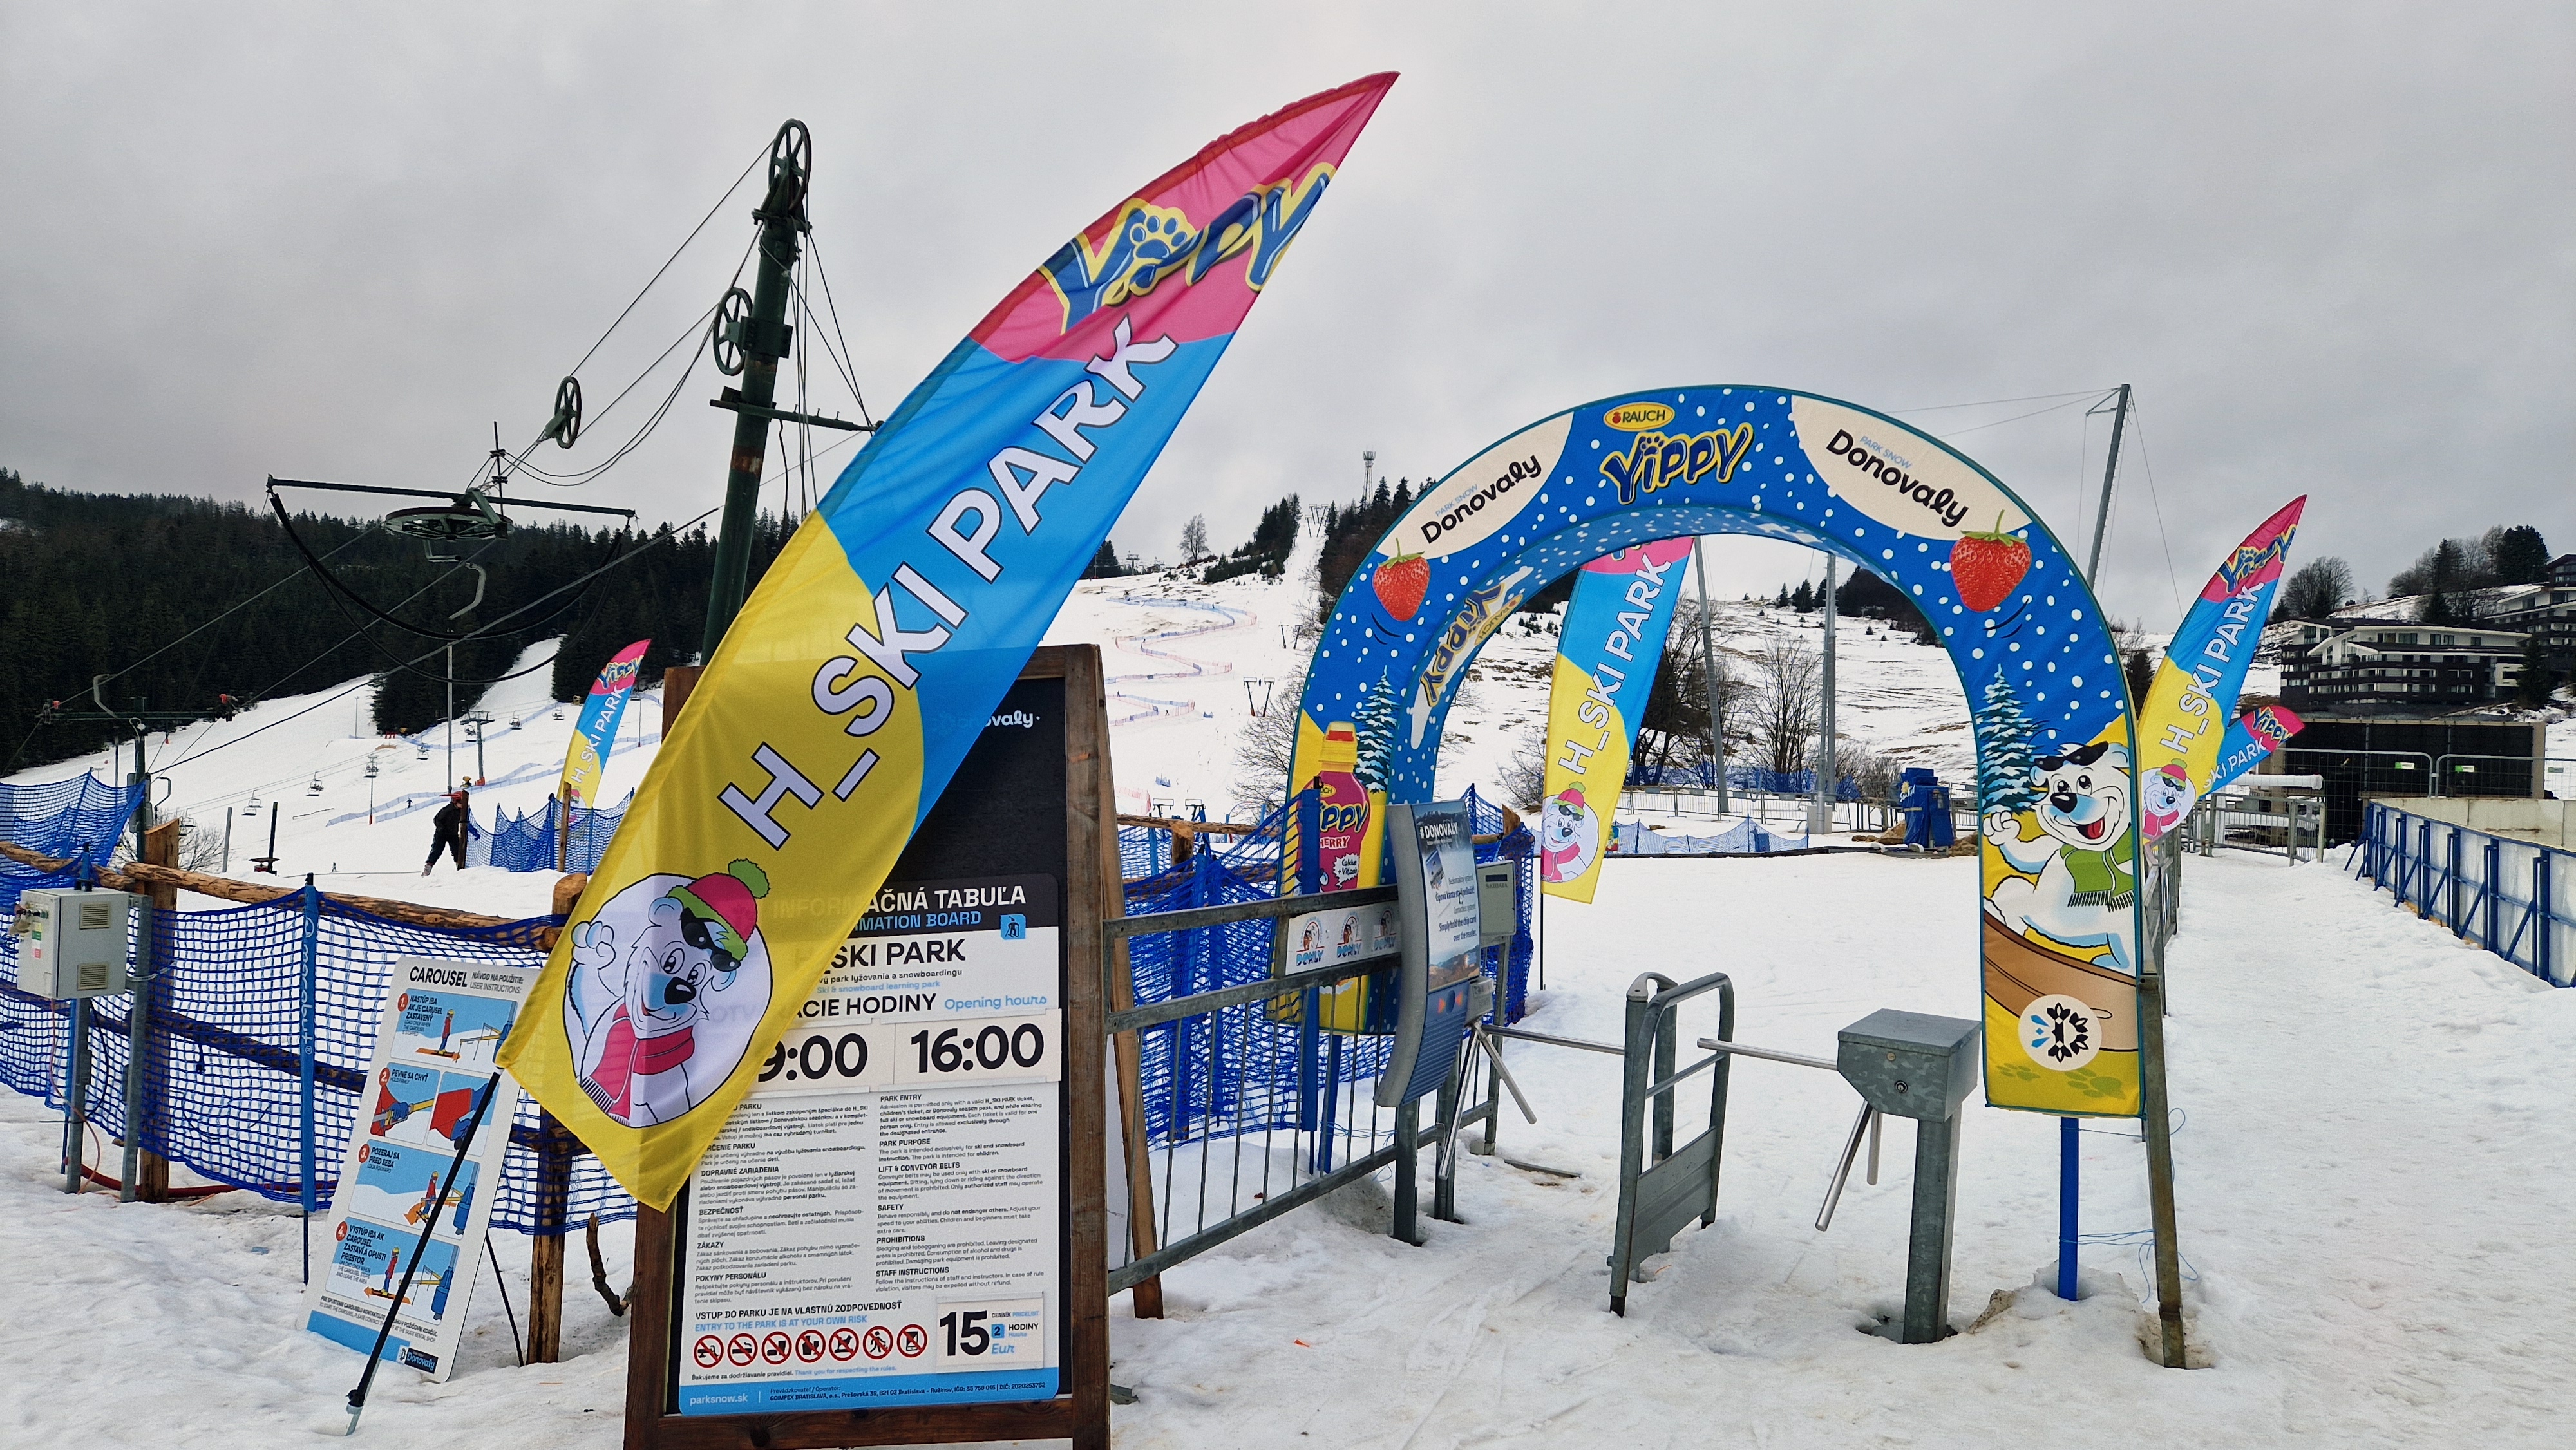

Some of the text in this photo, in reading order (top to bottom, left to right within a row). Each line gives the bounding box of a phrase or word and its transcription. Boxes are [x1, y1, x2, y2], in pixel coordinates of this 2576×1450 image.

[1621, 408, 1667, 424] RAUCH
[925, 314, 1180, 585] PARK
[1859, 435, 1913, 469] PARK SNOW
[1826, 429, 1969, 527] Donovaly
[1421, 455, 1542, 544] Donovaly
[1435, 484, 1479, 517] PARK SNOW
[1604, 553, 1672, 662] PARK
[2204, 582, 2265, 663] PARK
[594, 684, 625, 733] PARK
[2228, 736, 2266, 772] PARK
[934, 885, 1026, 909] TABUĽA
[926, 911, 981, 927] BOARD
[886, 938, 966, 965] PARK
[410, 966, 468, 988] CAROUSEL
[472, 970, 490, 980] NÁVOD
[831, 975, 849, 984] park
[851, 972, 890, 983] lyžovania
[899, 968, 962, 979] snowboardingu
[484, 983, 522, 993] INSTRUCTIONS:
[817, 985, 829, 994] Ski
[838, 983, 884, 992] snowboard
[886, 981, 920, 991] learning
[922, 980, 940, 988] park
[410, 995, 429, 1004] NASTÚP
[846, 993, 937, 1015] HODINY
[944, 997, 1001, 1012] Opening
[1005, 995, 1047, 1006] hours
[911, 1022, 1045, 1073] 16:00
[368, 1156, 394, 1168] PRED SEBA
[701, 1166, 779, 1176] DOPRAVNÉ ZARIADENIA
[699, 1206, 744, 1216] BEZPEČNOSŤ
[346, 1234, 372, 1247] CAROUSEL
[377, 1232, 385, 1241] AK
[876, 1235, 925, 1243] PROHIBITIONS
[726, 1272, 766, 1281] PERSONÁLU
[898, 1266, 949, 1276] INSTRUCTIONS
[696, 1312, 723, 1320] VSTUP
[795, 1304, 833, 1315] VLASTNÚ
[835, 1301, 902, 1312] ZODPOVEDNOSŤ
[695, 1323, 723, 1332] ENTRY
[801, 1317, 824, 1326] YOUR
[994, 1326, 1001, 1336] 2
[940, 1310, 990, 1356] 15
[991, 1344, 1014, 1354] Eur
[407, 1352, 435, 1371] Donovaly
[690, 1393, 748, 1406] parksnow.sk
